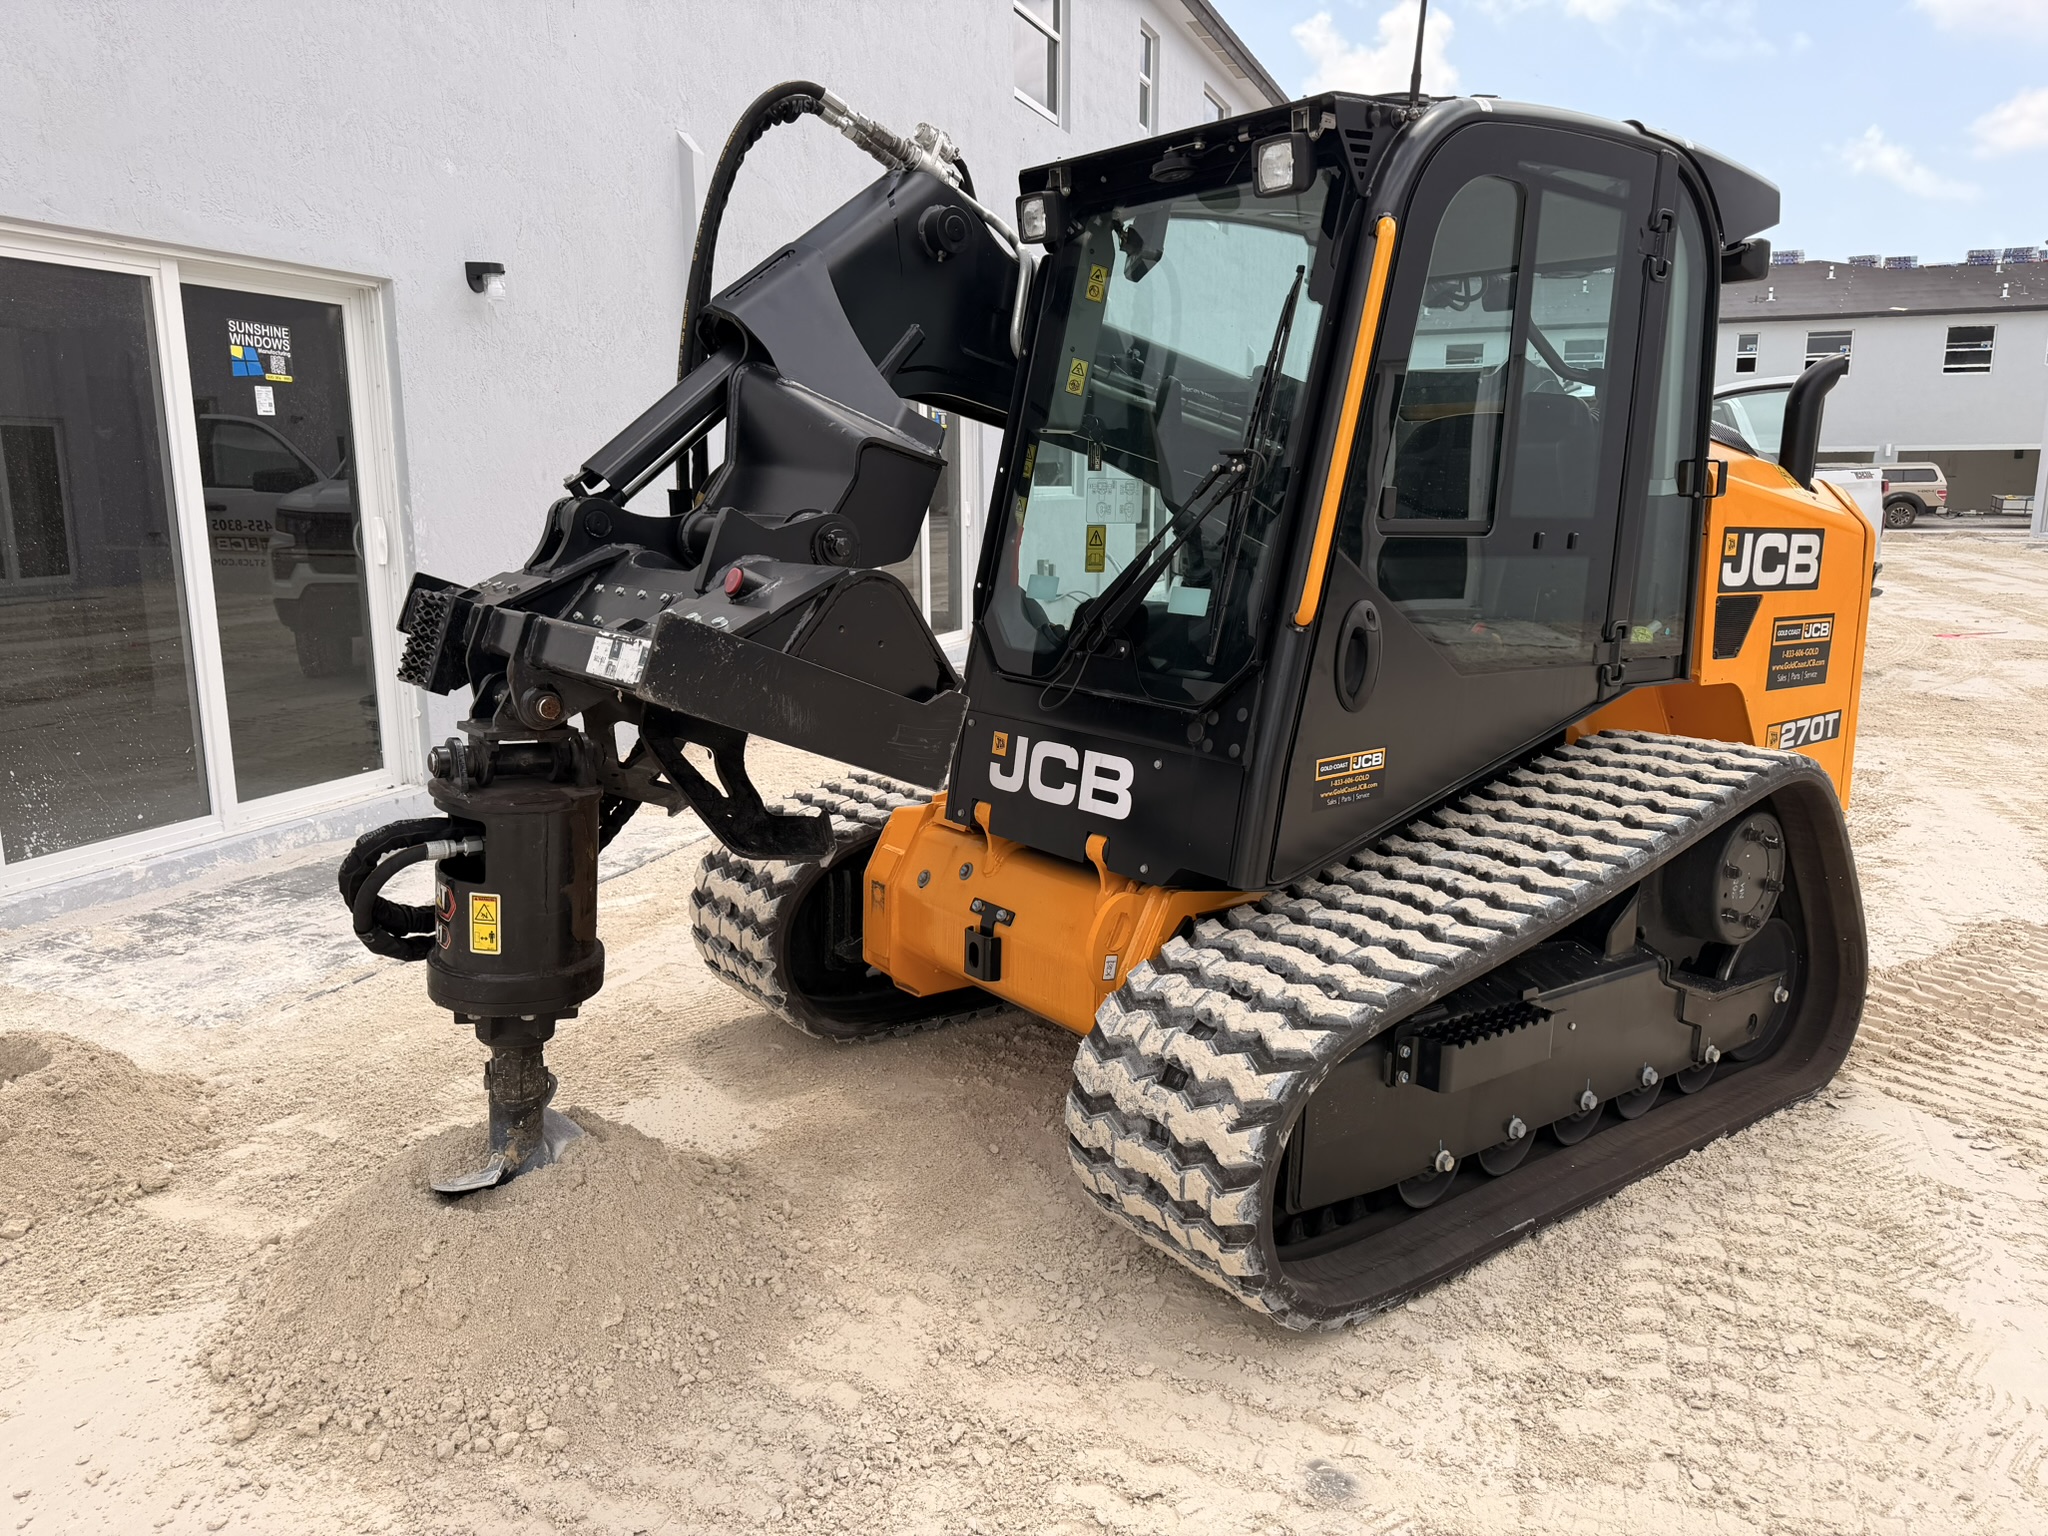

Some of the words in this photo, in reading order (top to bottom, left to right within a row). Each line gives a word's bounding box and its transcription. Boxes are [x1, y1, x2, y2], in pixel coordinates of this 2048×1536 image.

[228, 320, 289, 339] SUNSHINE
[229, 332, 290, 351] WINDOWS
[258, 348, 291, 358] Manufacturing
[1722, 533, 1820, 587] JCB
[1804, 622, 1830, 638] JCB
[1777, 673, 1787, 682] Sales
[1791, 672, 1801, 680] Parts
[1804, 670, 1818, 679] Service
[1779, 712, 1840, 749] 270T
[1352, 752, 1383, 769] JCB
[988, 735, 1134, 820] JCB
[1330, 774, 1370, 787] 1-833-606-GOLD
[1326, 798, 1337, 806] Sales
[1356, 792, 1370, 800] Service
